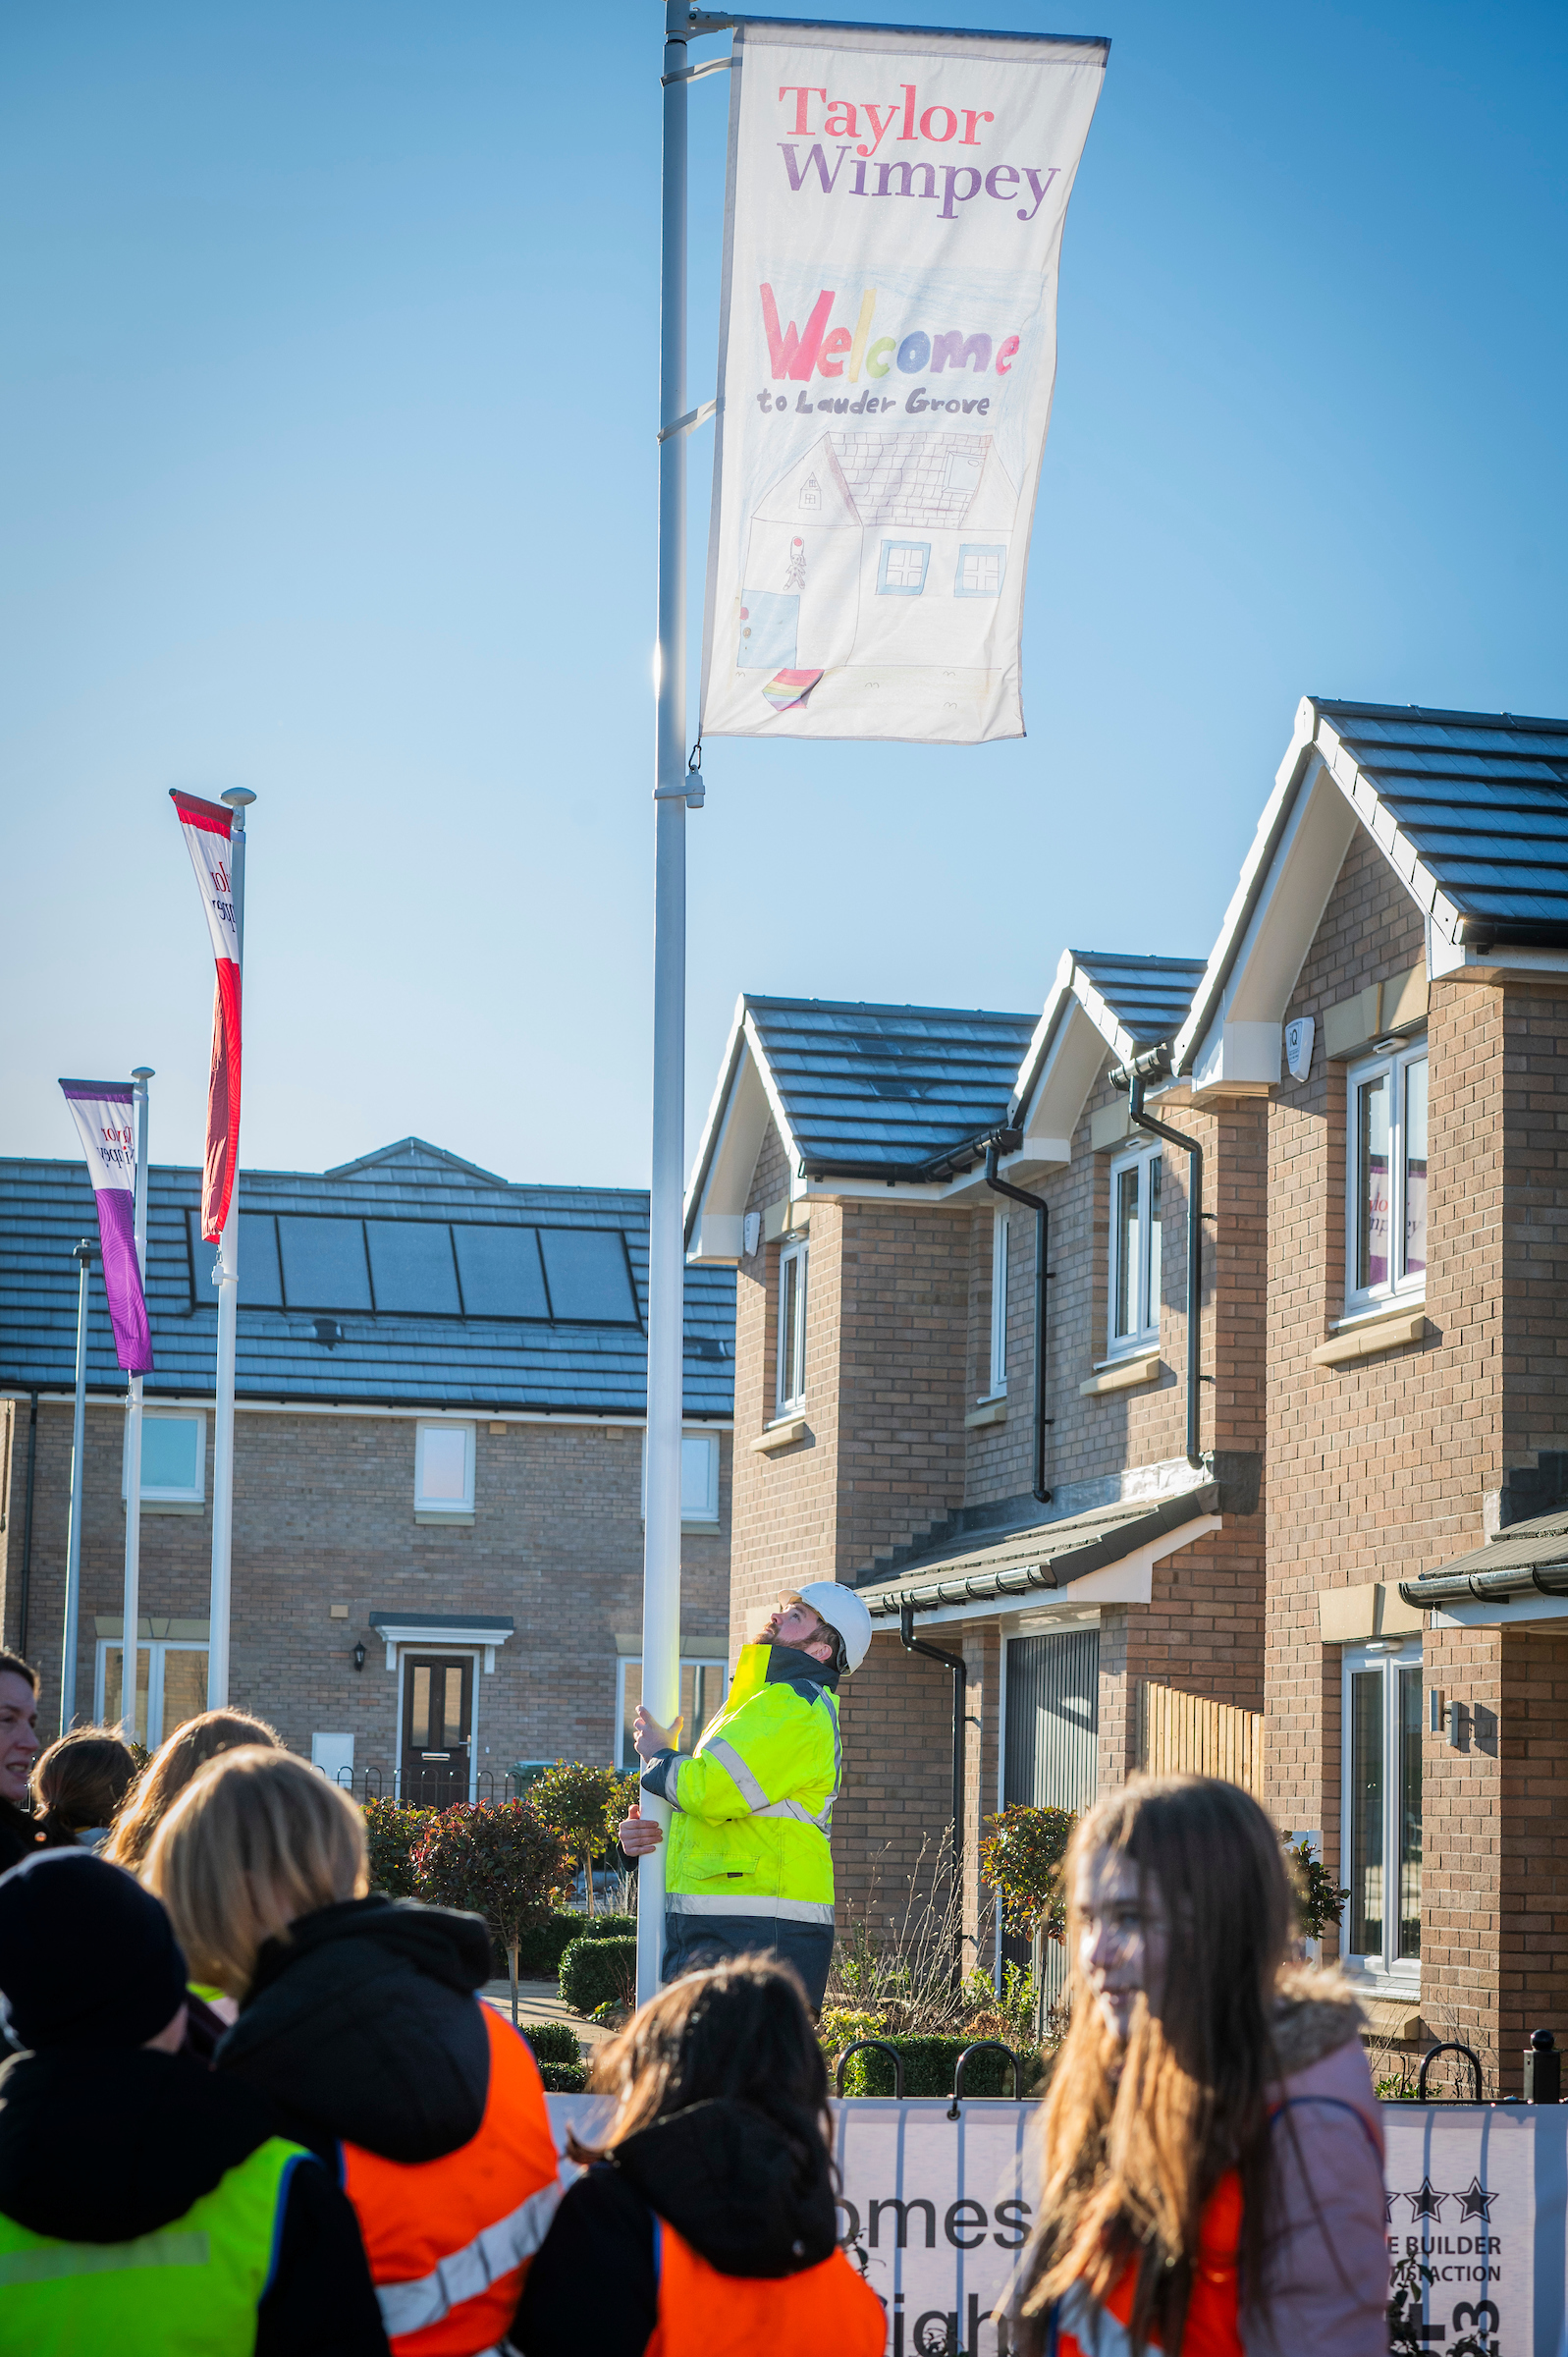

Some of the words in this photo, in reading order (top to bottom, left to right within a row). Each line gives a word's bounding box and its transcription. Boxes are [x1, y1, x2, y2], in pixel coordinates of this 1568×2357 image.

[779, 84, 995, 157] Taylor
[777, 142, 1061, 221] Wimpey
[759, 282, 1020, 383] Welcome
[757, 387, 787, 414] to
[795, 390, 896, 414] Lauder
[905, 387, 991, 415] Grove
[1406, 2235, 1501, 2255] BUILDER
